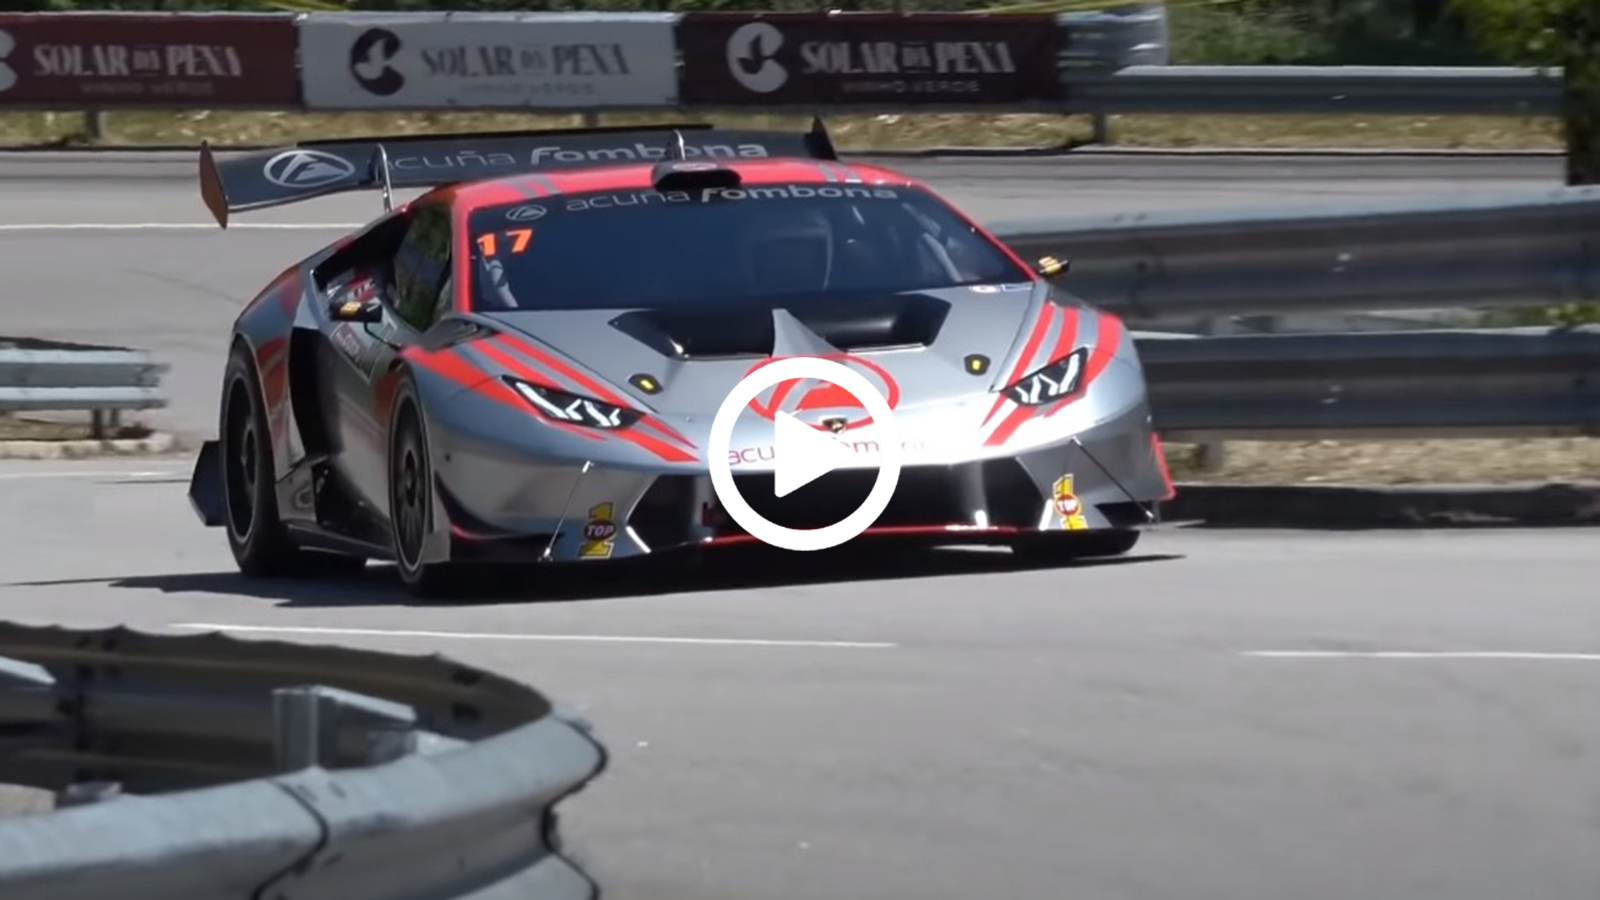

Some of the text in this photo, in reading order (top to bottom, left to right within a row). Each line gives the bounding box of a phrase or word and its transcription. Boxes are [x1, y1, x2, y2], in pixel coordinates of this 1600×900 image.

[33, 44, 130, 76] SOLAR
[164, 44, 243, 76] PEXA
[420, 45, 515, 76] SOLAR
[552, 44, 630, 75] PEXA
[800, 42, 899, 73] SOLAR
[934, 42, 1015, 73] PEXA
[476, 228, 533, 256] 17
[586, 524, 615, 537] TOP
